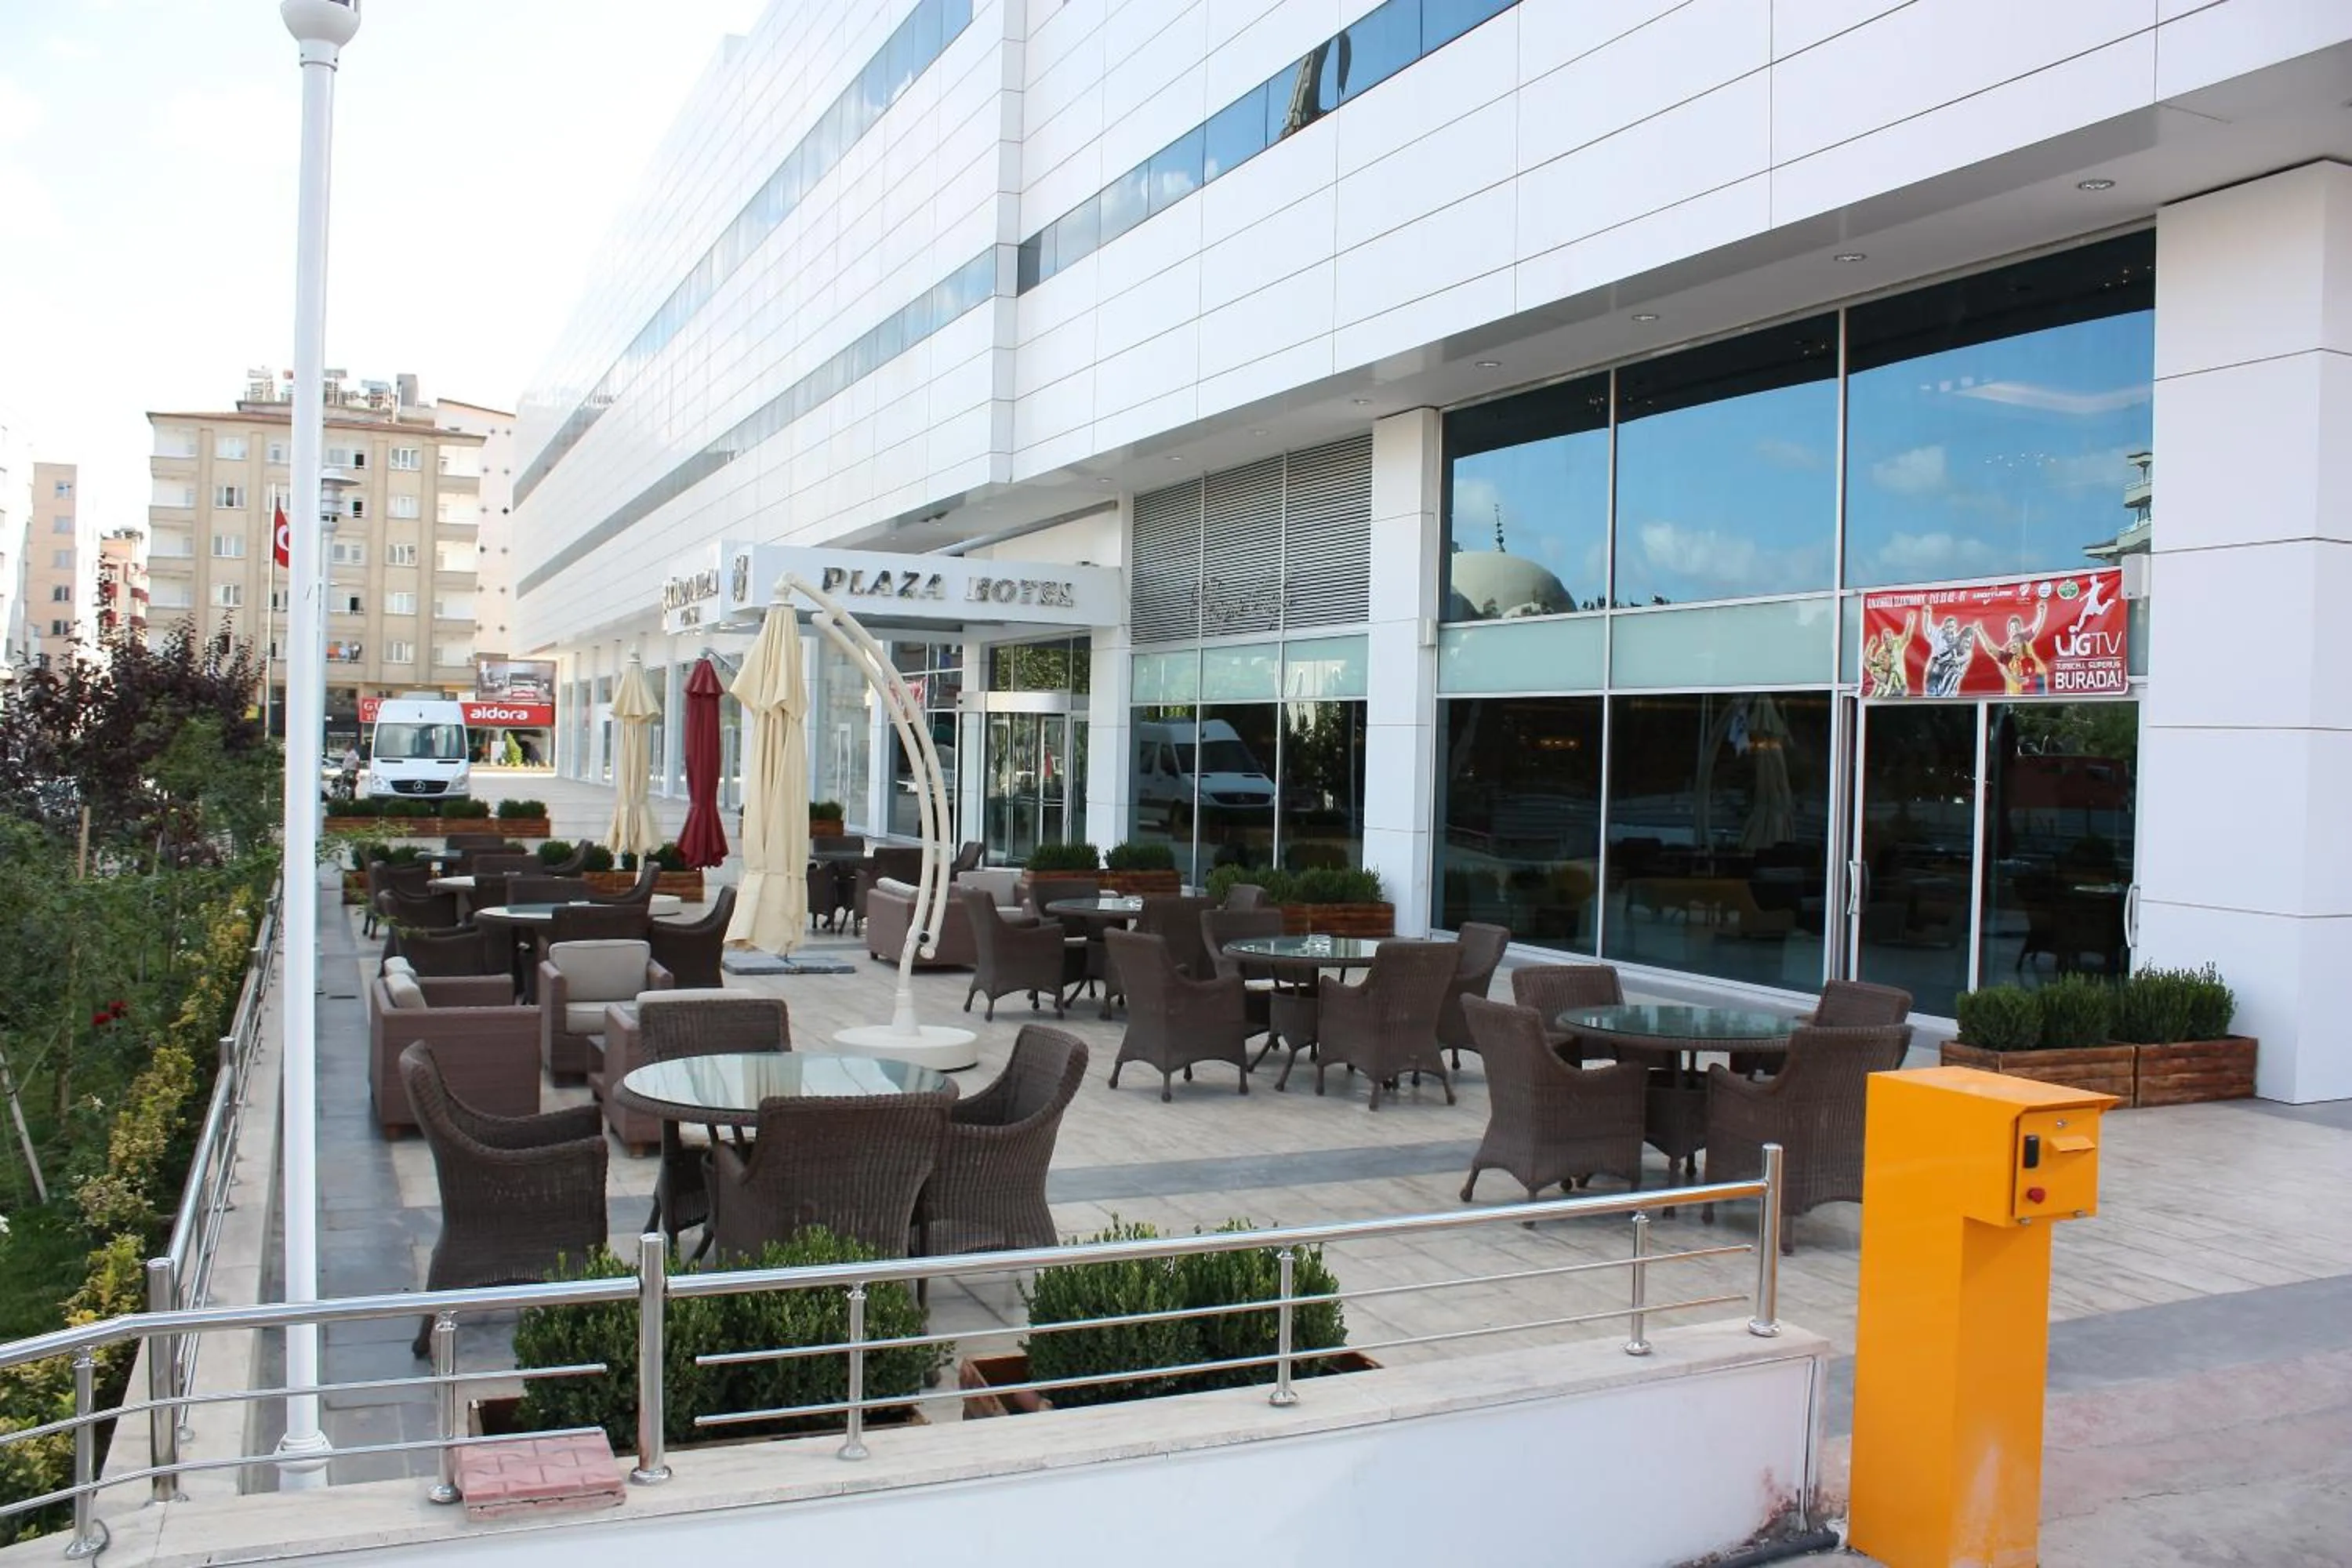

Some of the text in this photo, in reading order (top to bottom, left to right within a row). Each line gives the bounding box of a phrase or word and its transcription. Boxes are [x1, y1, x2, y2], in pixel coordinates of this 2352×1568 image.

[822, 567, 1075, 608] PLAZA HOTEL
[2055, 670, 2122, 690] BURADA!
[470, 706, 528, 720] aldora
